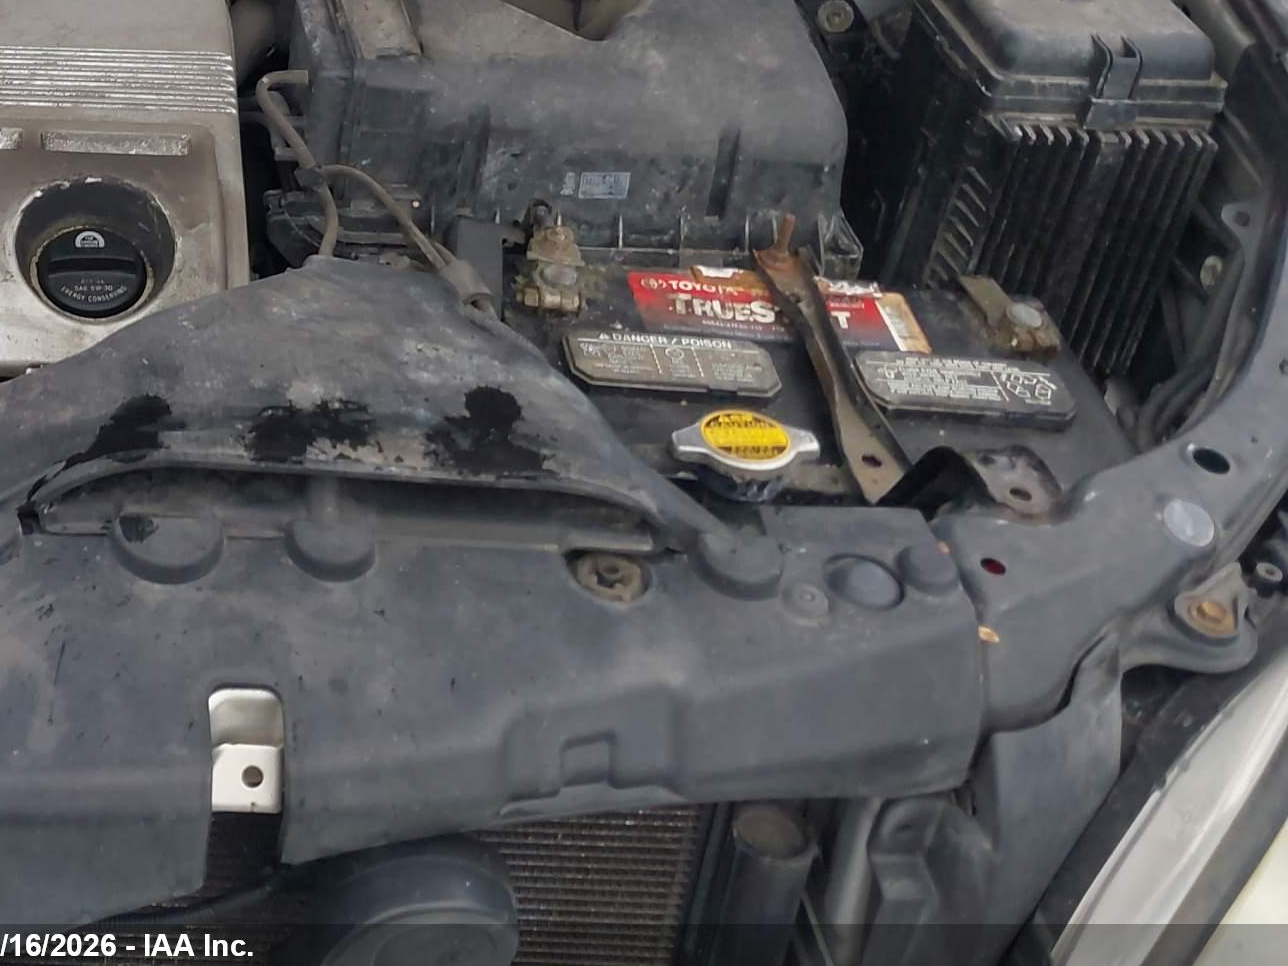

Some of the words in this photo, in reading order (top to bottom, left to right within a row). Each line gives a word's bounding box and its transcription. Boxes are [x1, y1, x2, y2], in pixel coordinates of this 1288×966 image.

[60, 285, 86, 301] ENERGY
[612, 333, 668, 345] DANGER
[681, 337, 732, 350] POISON
